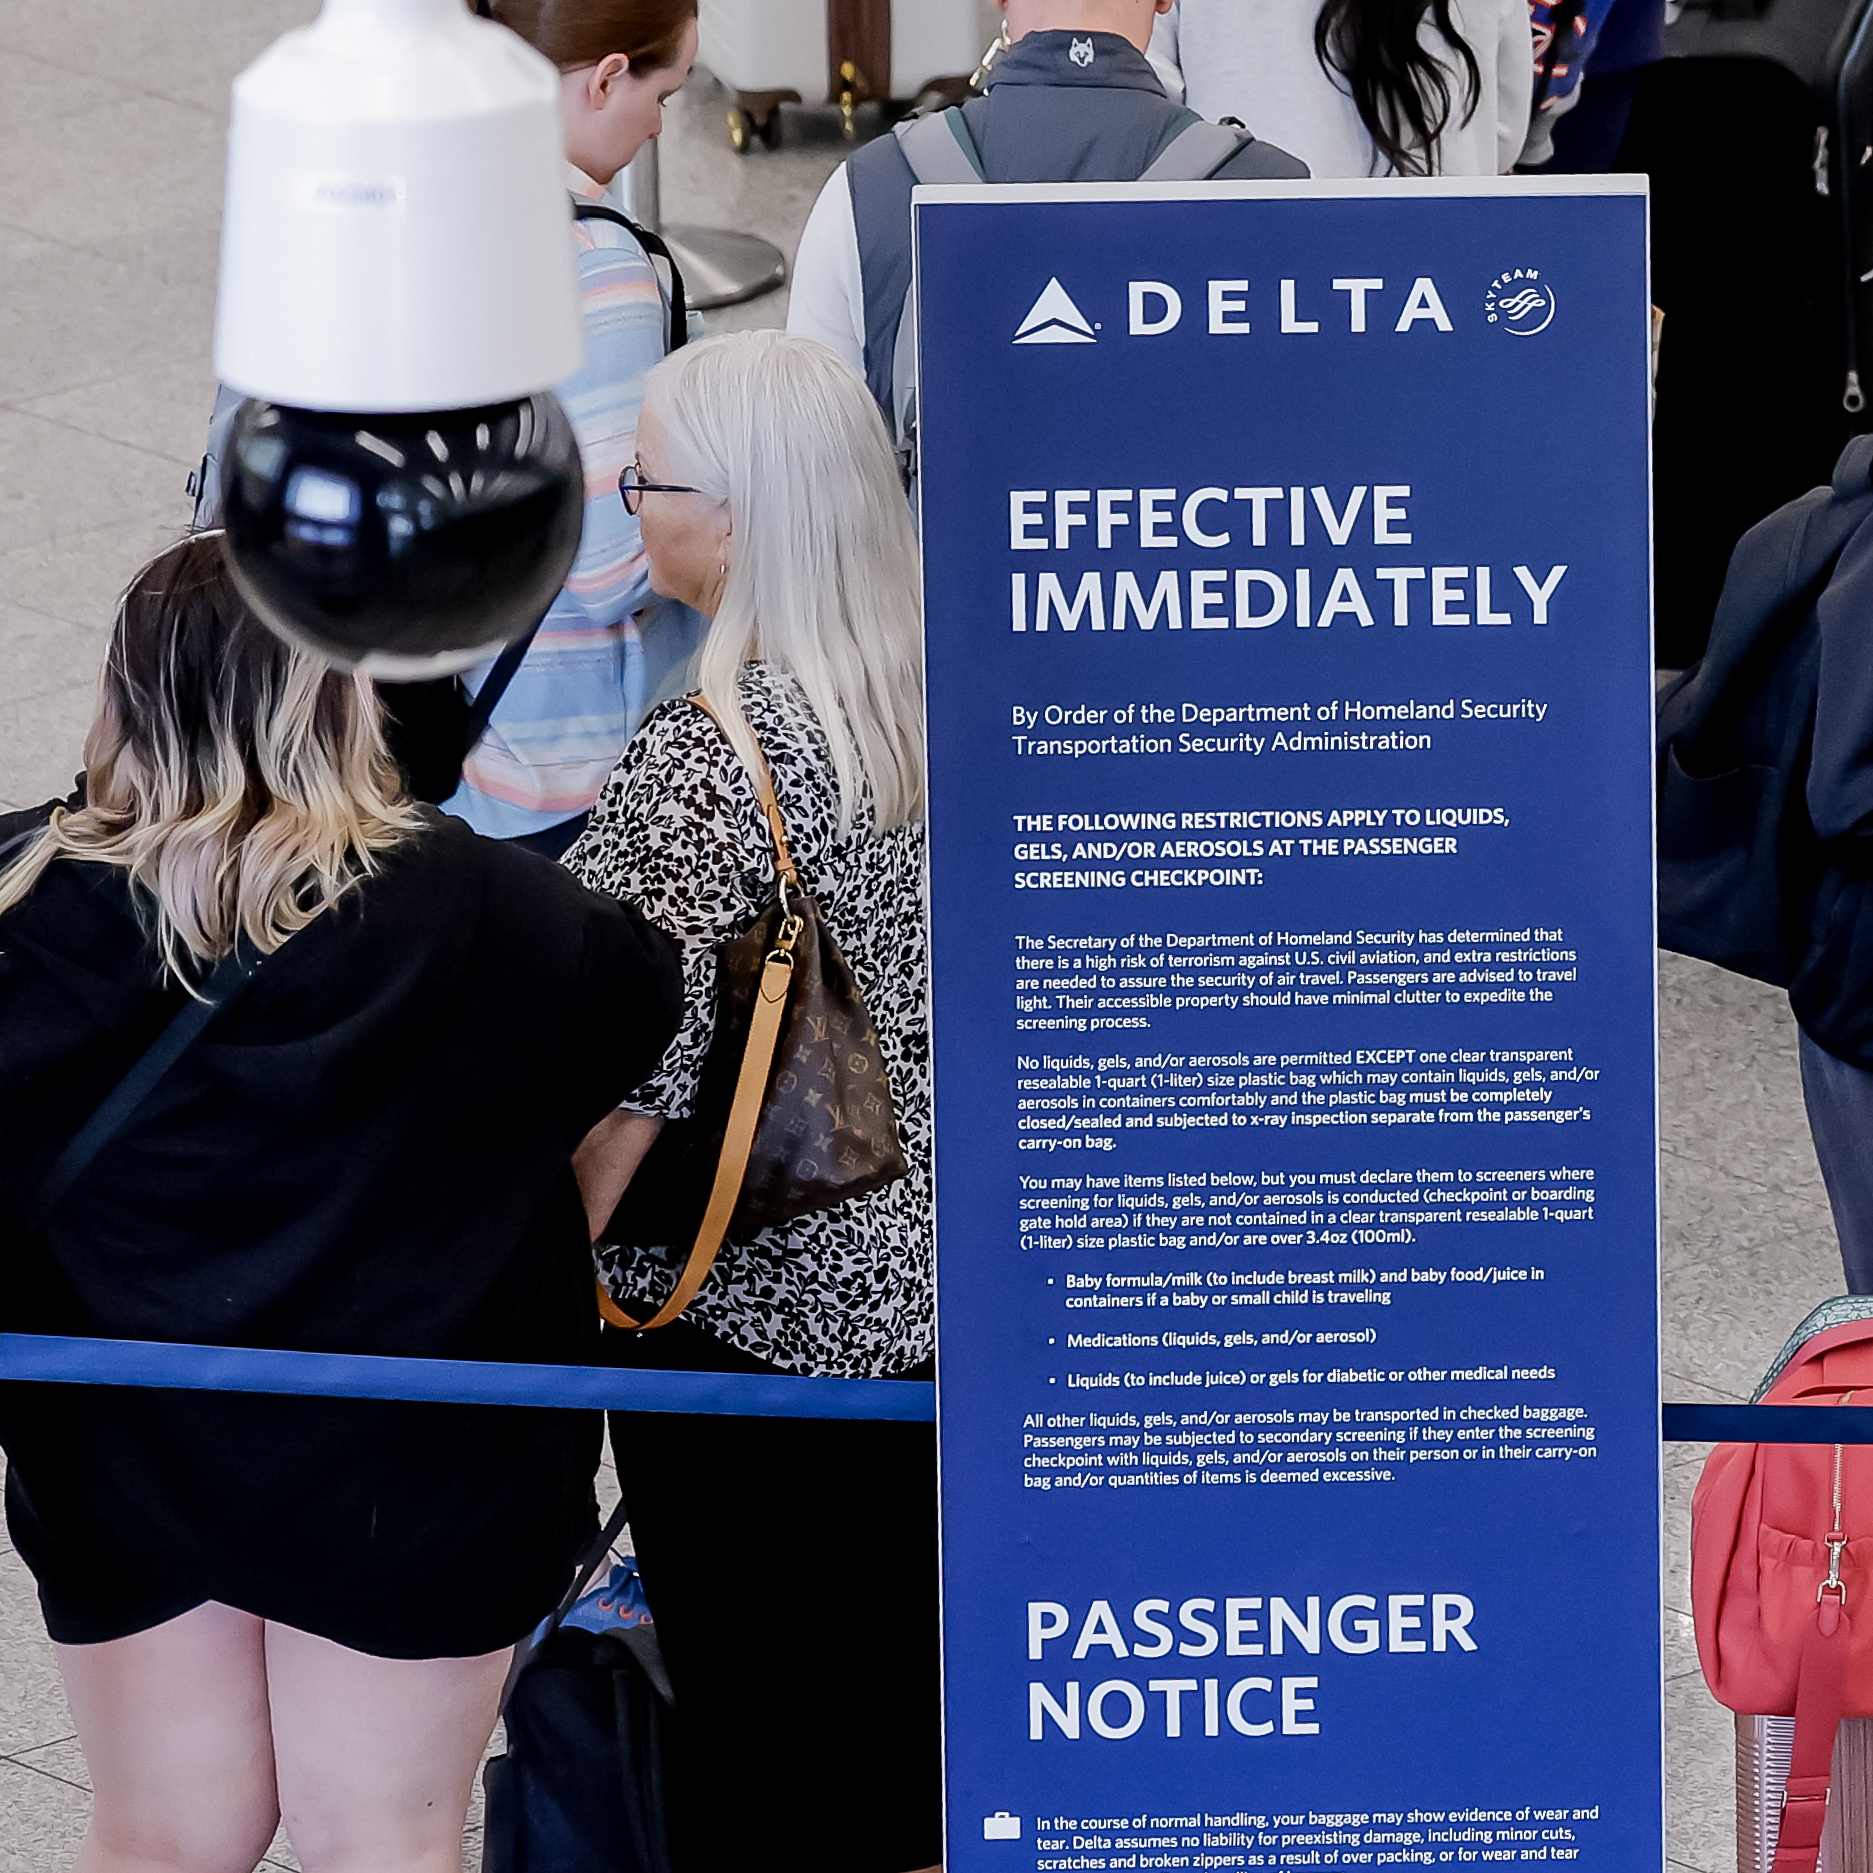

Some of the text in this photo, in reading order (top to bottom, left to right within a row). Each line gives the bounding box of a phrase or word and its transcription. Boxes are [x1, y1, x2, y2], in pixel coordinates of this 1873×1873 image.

[1128, 277, 1454, 336] DELTA
[1484, 268, 1540, 323] SKYTEAM
[1009, 483, 1412, 551] EFFECTIVE
[1011, 563, 1568, 633] IMMEDIATELY
[1012, 697, 1548, 729] By Order of the Department of Homeland Security
[1011, 728, 1431, 759] Transportation Security Administration
[1012, 808, 1510, 832] THE FOLLOWING RESTRICTIONS APPLY TO LIQUIDS,
[1013, 837, 1458, 863] GELS, AND/OR AEROSOLS AT THE PASSENGER
[1014, 868, 1264, 889] SCREENING CHECKPOINT:
[1014, 927, 1564, 952] The Secretary of the Department of Homeland Security has determined that
[1015, 946, 1577, 972] there is a high risk of terrorism against U.S. civil aviation, and extra restrictions
[1016, 1015, 1151, 1033] screening process.
[1017, 1047, 1574, 1072] No liquids, gels, and/or aerosols are permitted EXCEPT one clear transparent
[1017, 1106, 1591, 1131] closed/sealed and subjected to x-ray inspection separate from the passenger's
[1018, 1133, 1117, 1152] carry-on bag.
[1020, 1228, 1416, 1251] (1-liter) size plastic bag and/or are over 3.4oz (100ml).
[1065, 1288, 1392, 1308] containers if a baby or small child is traveling
[1067, 1328, 1377, 1349] Medications (liquids, gels, and/or aerosol)
[1022, 1403, 1588, 1429] All other liquids, gels, and/or aerosols may be transported in checked baggage.
[1024, 1467, 1396, 1491] bag and/or quantities of items is deemed excessive.
[1027, 1592, 1478, 1660] PASSENGER
[1029, 1676, 1320, 1741] NOTICE
[1036, 1805, 1599, 1831] In the course of normal handling, your baggage may show evidence of wear and
